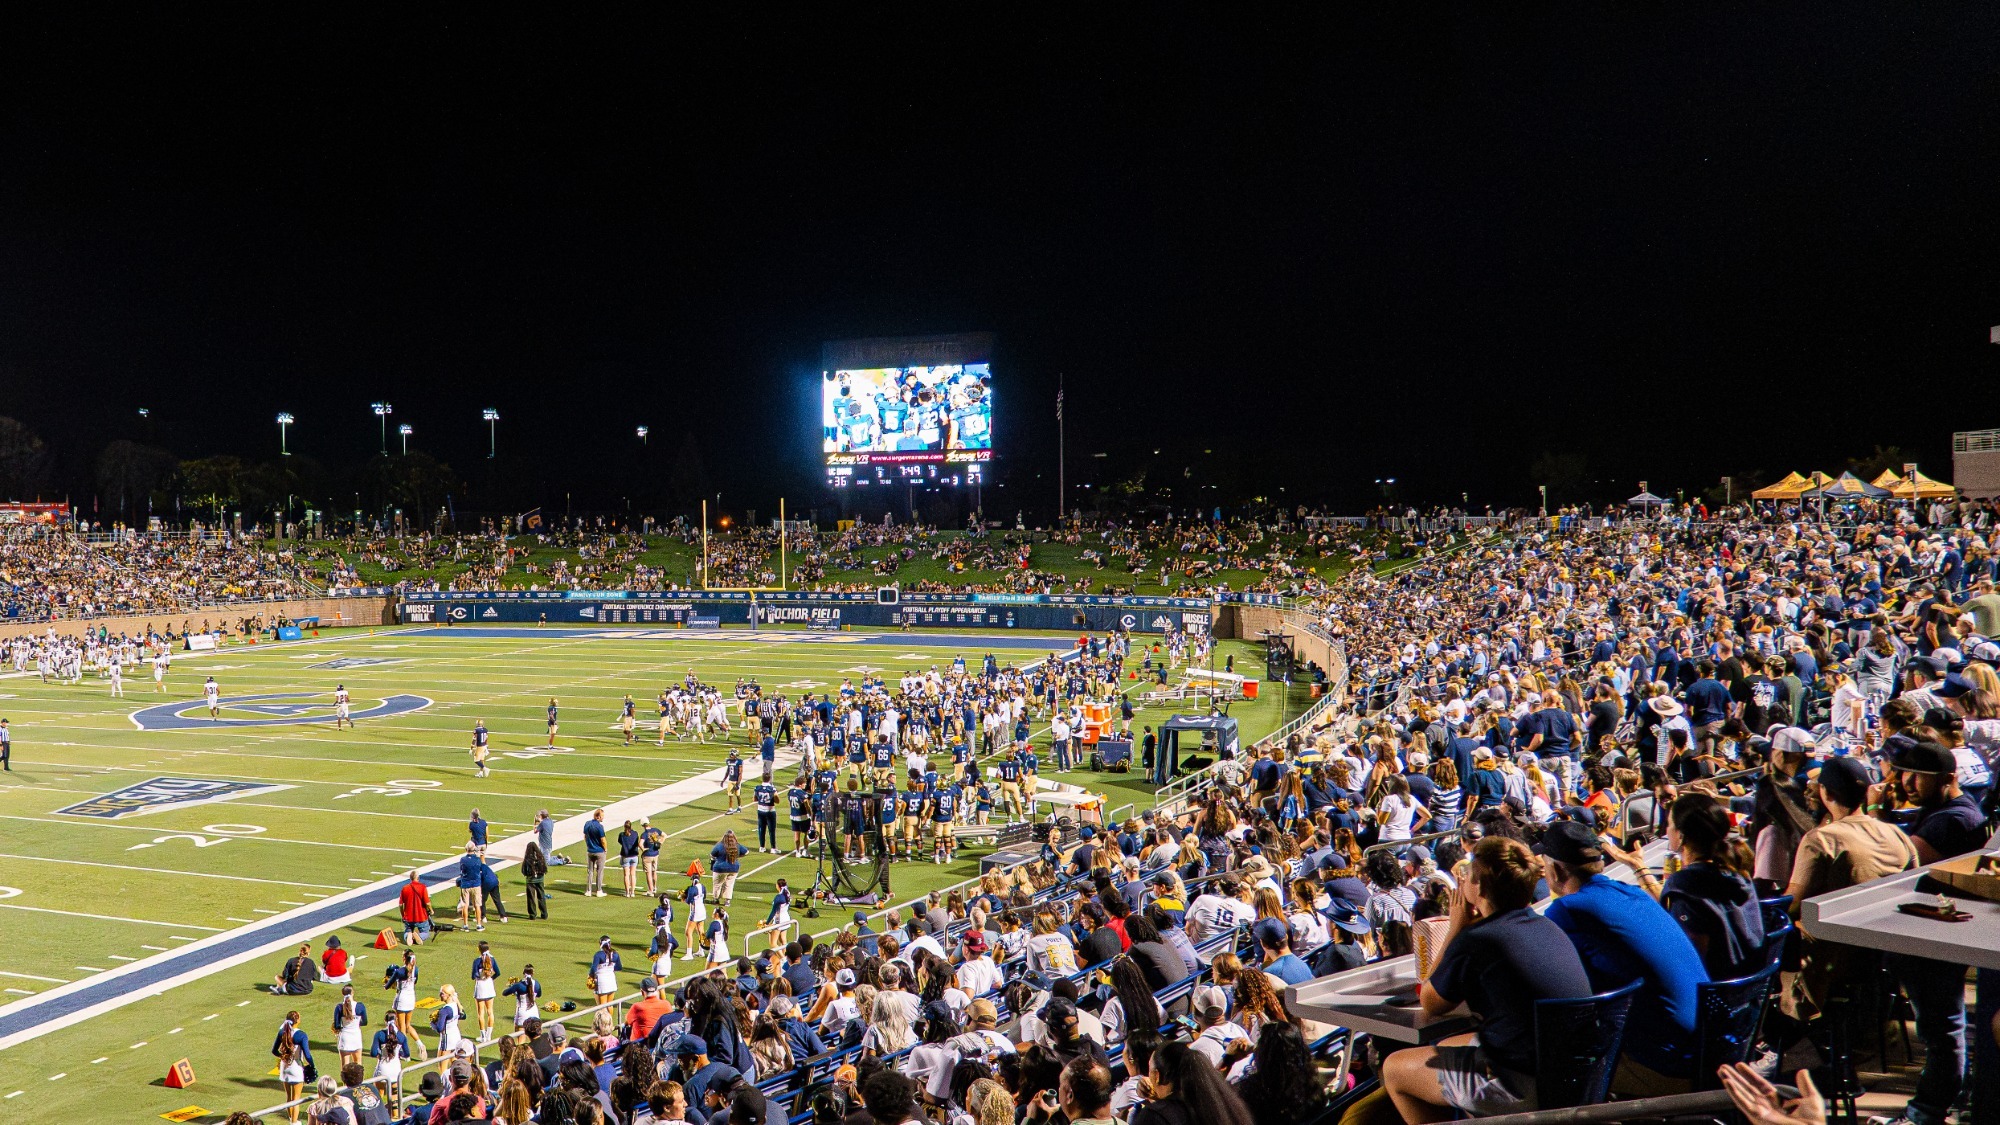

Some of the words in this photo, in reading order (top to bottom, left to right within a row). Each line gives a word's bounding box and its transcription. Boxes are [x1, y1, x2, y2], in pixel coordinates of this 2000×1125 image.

[857, 454, 870, 464] VR
[977, 451, 991, 461] VR
[899, 465, 921, 476] 7:49
[834, 476, 847, 487] 36
[952, 475, 959, 486] 3
[967, 473, 981, 484] 27
[405, 604, 435, 613] MUSCLE
[747, 607, 765, 620] JM
[767, 607, 809, 620] OCHOR
[811, 607, 841, 619] FIELD
[411, 613, 430, 622] MILK
[1182, 613, 1209, 624] MUSCLE
[209, 687, 216, 695] 31
[690, 708, 698, 717] 12
[831, 730, 841, 740] 80
[911, 724, 922, 735] 34
[877, 749, 889, 761] 66
[961, 750, 967, 762] 5
[1005, 767, 1015, 779] 11
[69, 798, 148, 815] BIG
[115, 778, 231, 803] SKY
[758, 792, 771, 804] 72
[789, 795, 800, 809] 76
[940, 795, 952, 809] 60
[908, 798, 921, 812] 55
[152, 823, 268, 848] 20
[383, 929, 396, 948] 10
[177, 1061, 193, 1084] G
